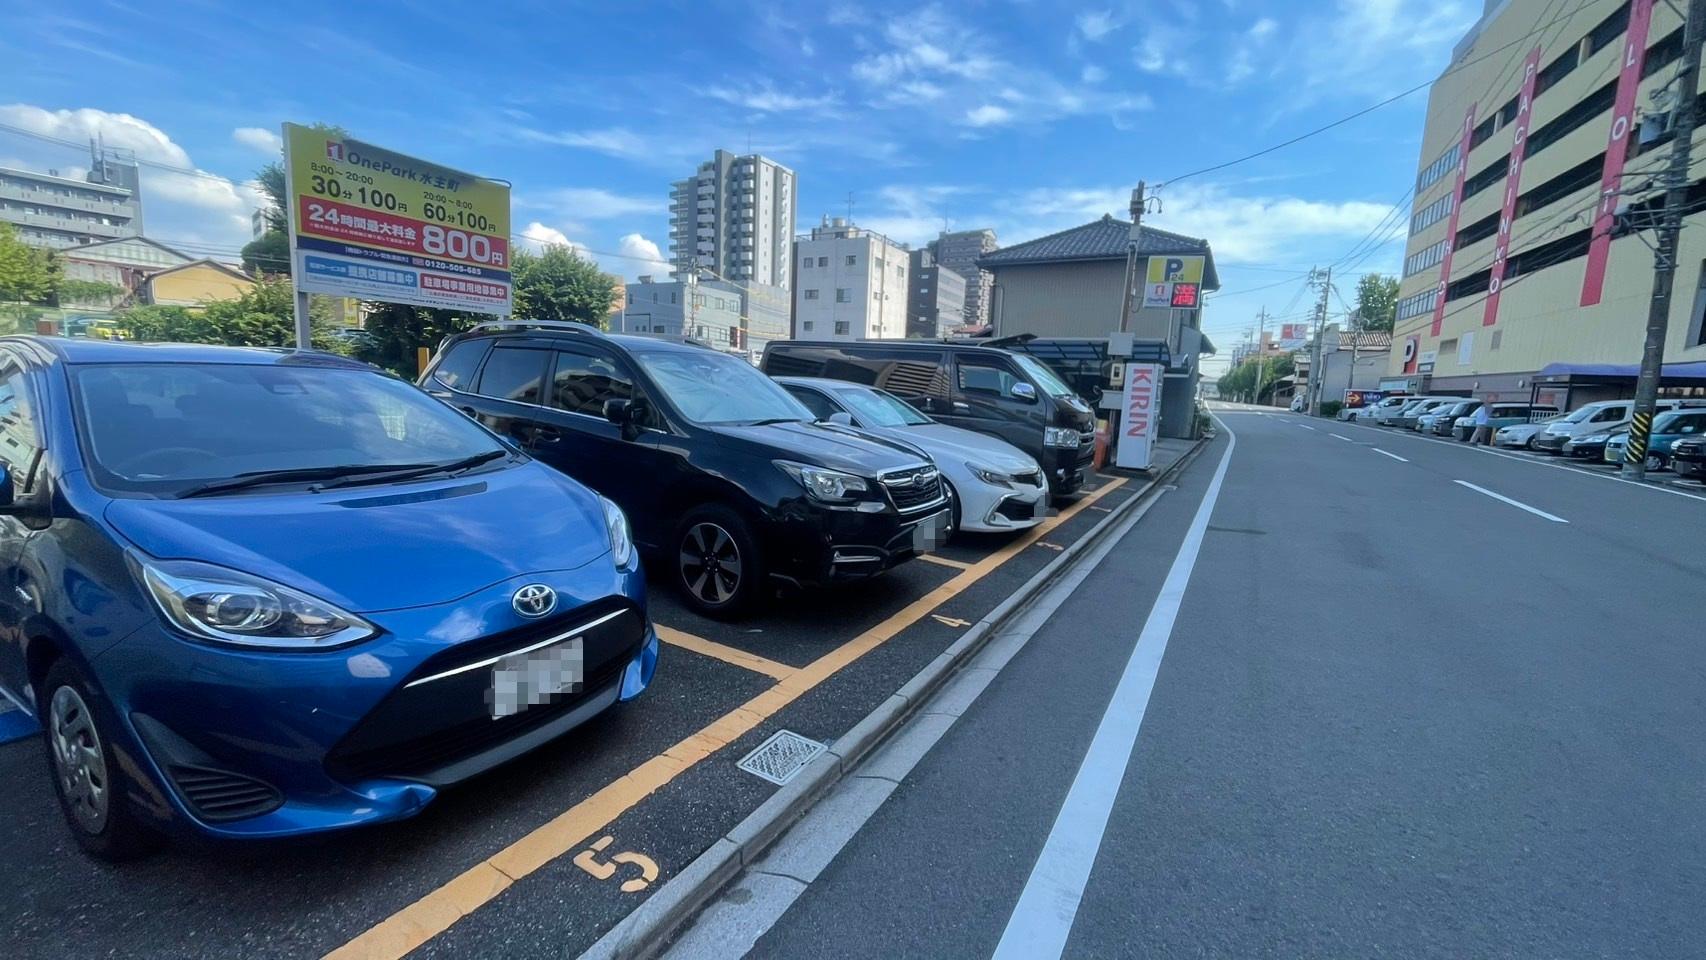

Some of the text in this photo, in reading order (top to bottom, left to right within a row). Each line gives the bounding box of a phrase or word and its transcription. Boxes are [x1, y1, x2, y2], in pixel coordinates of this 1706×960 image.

[347, 151, 461, 193] OnePark 水主町
[1489, 64, 1535, 294] PACHINKO
[307, 204, 417, 240] 24時間最大料金
[1164, 258, 1184, 281] P
[1173, 284, 1197, 305] 満
[1127, 368, 1152, 437] KIRIN
[931, 614, 972, 628] 4
[573, 835, 659, 893] 5
